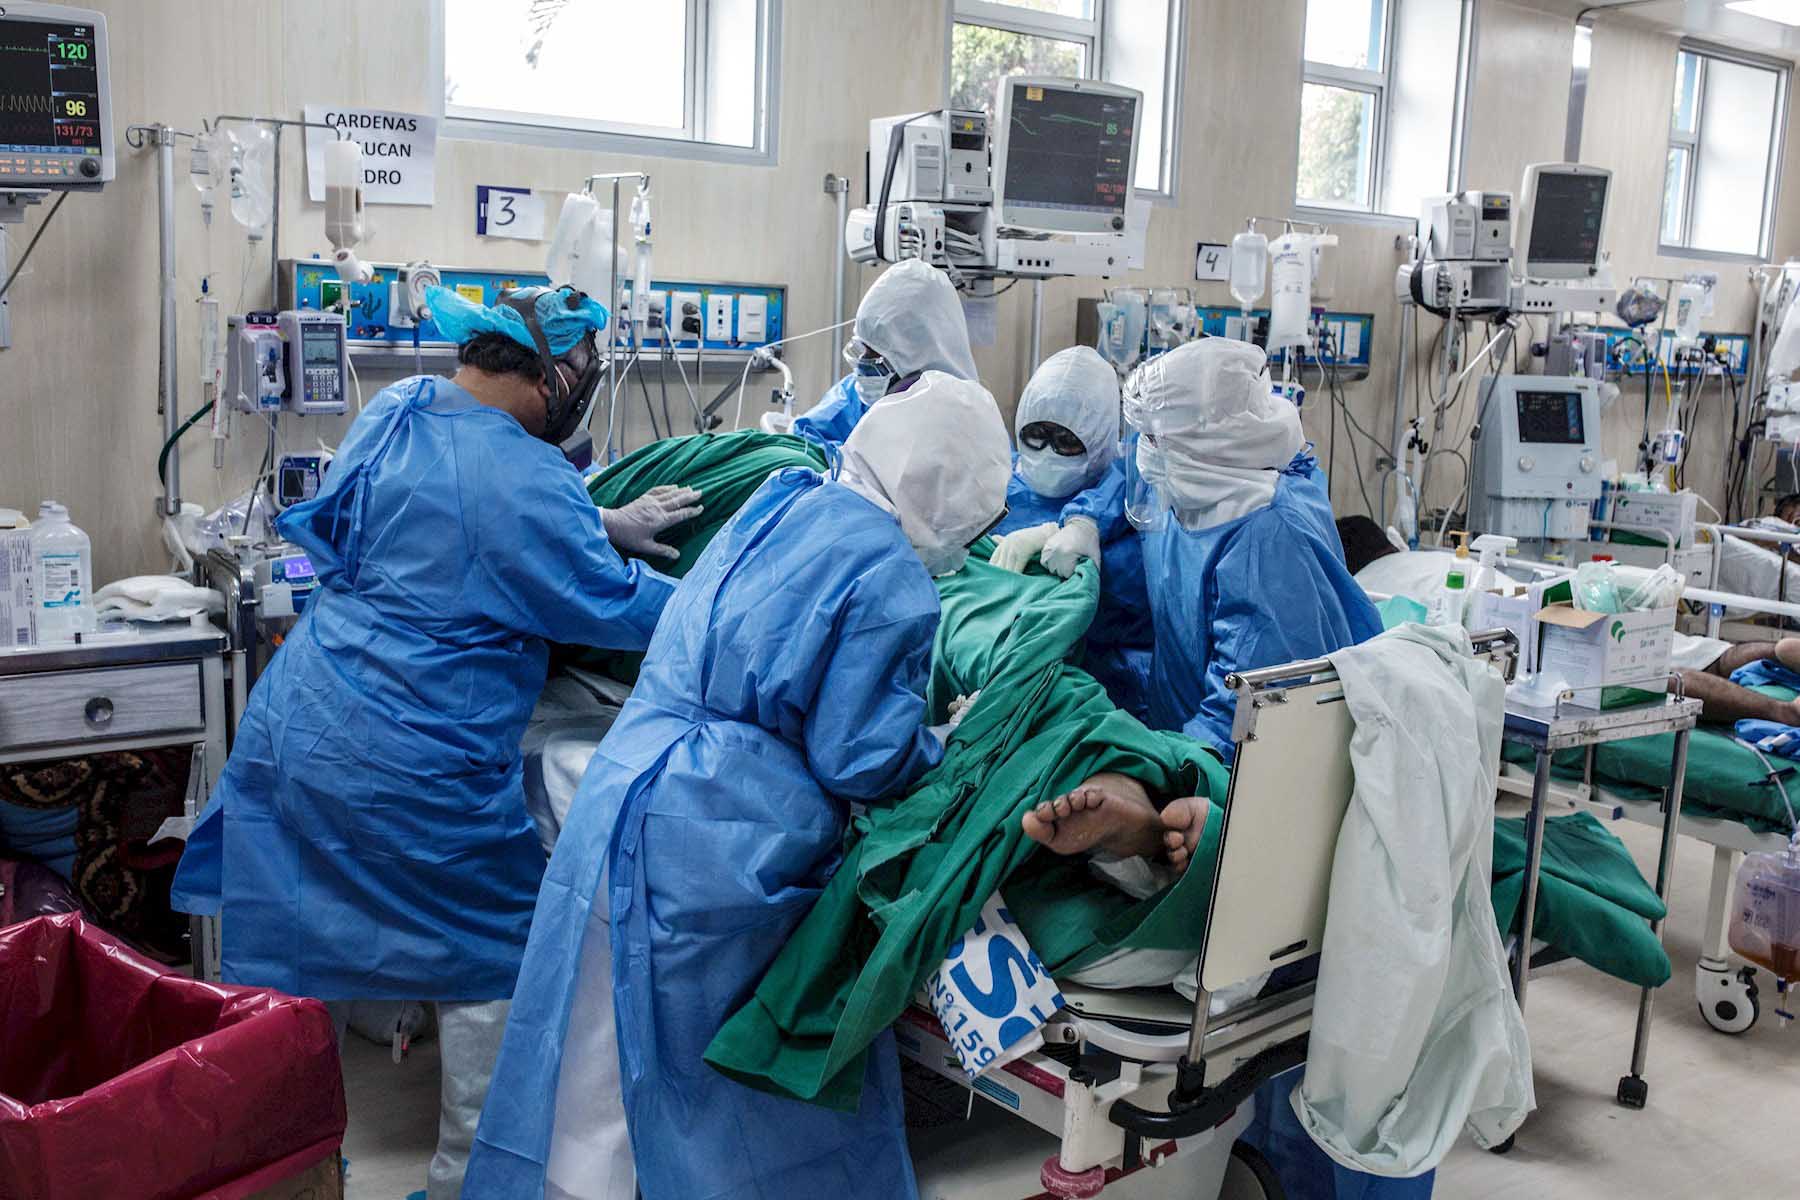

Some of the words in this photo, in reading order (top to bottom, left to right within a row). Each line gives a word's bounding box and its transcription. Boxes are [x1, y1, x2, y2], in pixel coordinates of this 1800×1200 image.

[57, 43, 88, 60] 120
[65, 100, 87, 117] 96
[325, 112, 417, 132] CARDENAS
[55, 125, 94, 138] 131/73
[355, 141, 412, 158] UCAN
[360, 168, 402, 185] DRO
[495, 196, 516, 226] 3
[1206, 251, 1220, 273] 4
[953, 1011, 998, 1068] 159
